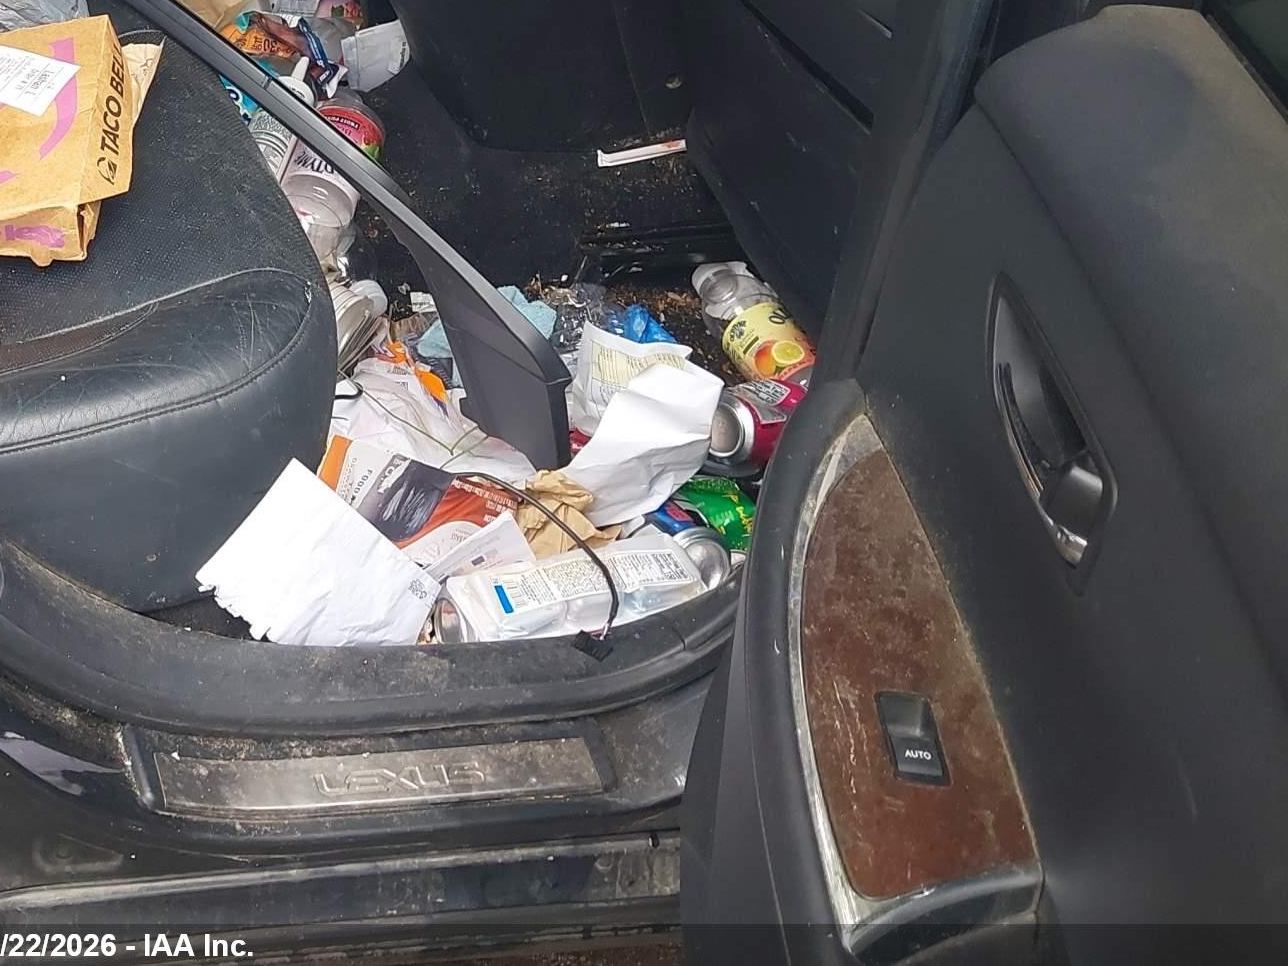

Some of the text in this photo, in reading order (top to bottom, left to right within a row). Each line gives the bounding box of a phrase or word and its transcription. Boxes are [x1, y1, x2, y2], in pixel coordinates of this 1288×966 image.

[100, 42, 124, 156] TACO BELL
[904, 748, 932, 761] AUTO
[313, 761, 486, 796] LEXUS
